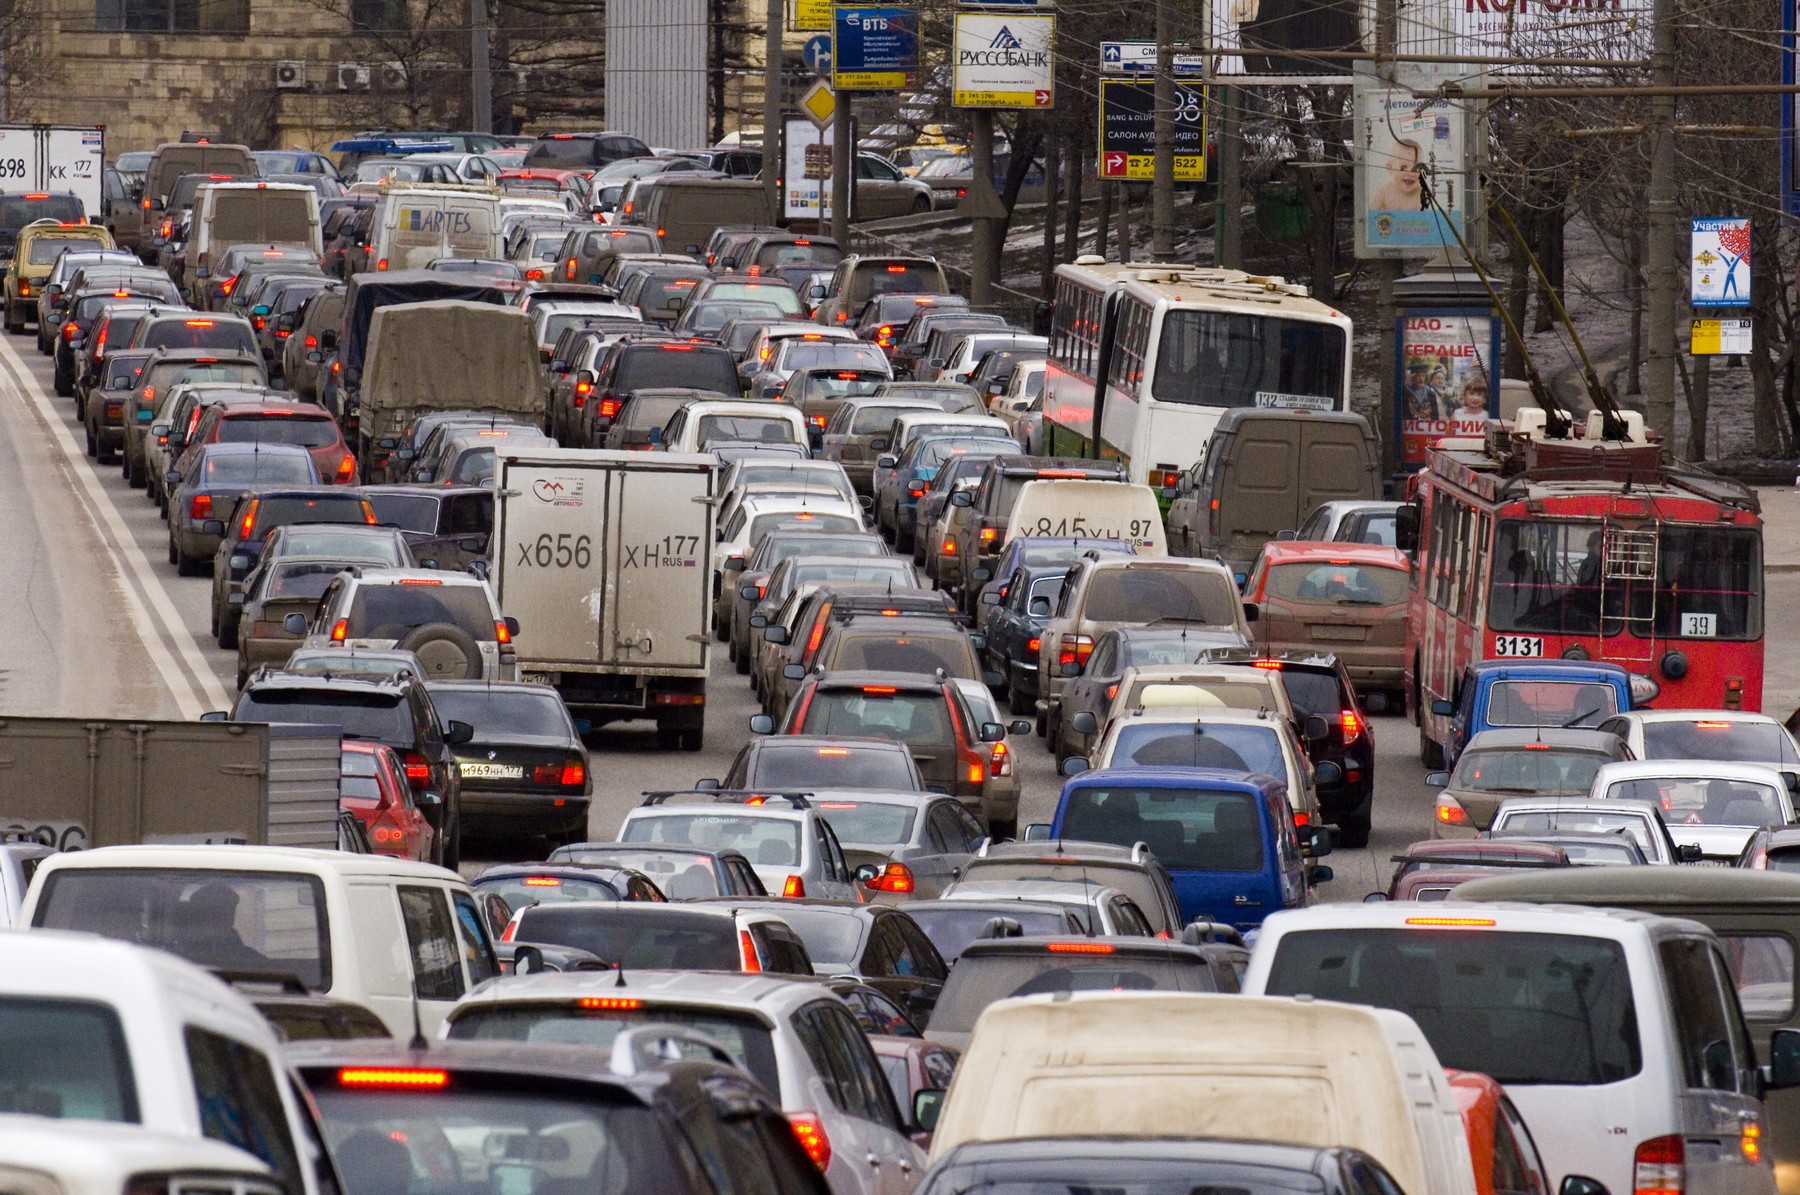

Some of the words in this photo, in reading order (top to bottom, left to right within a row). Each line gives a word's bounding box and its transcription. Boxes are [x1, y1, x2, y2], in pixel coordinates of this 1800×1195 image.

[863, 19, 888, 30] ВТБ
[960, 51, 1048, 67] РУССОБАНК
[1108, 131, 1137, 139] САЛОН
[1139, 131, 1155, 139] АУД
[1175, 132, 1199, 140] ИДЕО
[0, 158, 26, 178] 698
[421, 210, 472, 233] ARTES
[1693, 221, 1737, 231] Участие
[1404, 319, 1441, 330] ЦАО
[1405, 344, 1474, 358] СЕРДЦЕ
[1259, 393, 1277, 407] 132
[1130, 520, 1152, 537] 97
[663, 536, 700, 555] 177
[662, 557, 683, 568] RUS
[1689, 616, 1709, 636] 39
[1496, 637, 1543, 656] 3131
